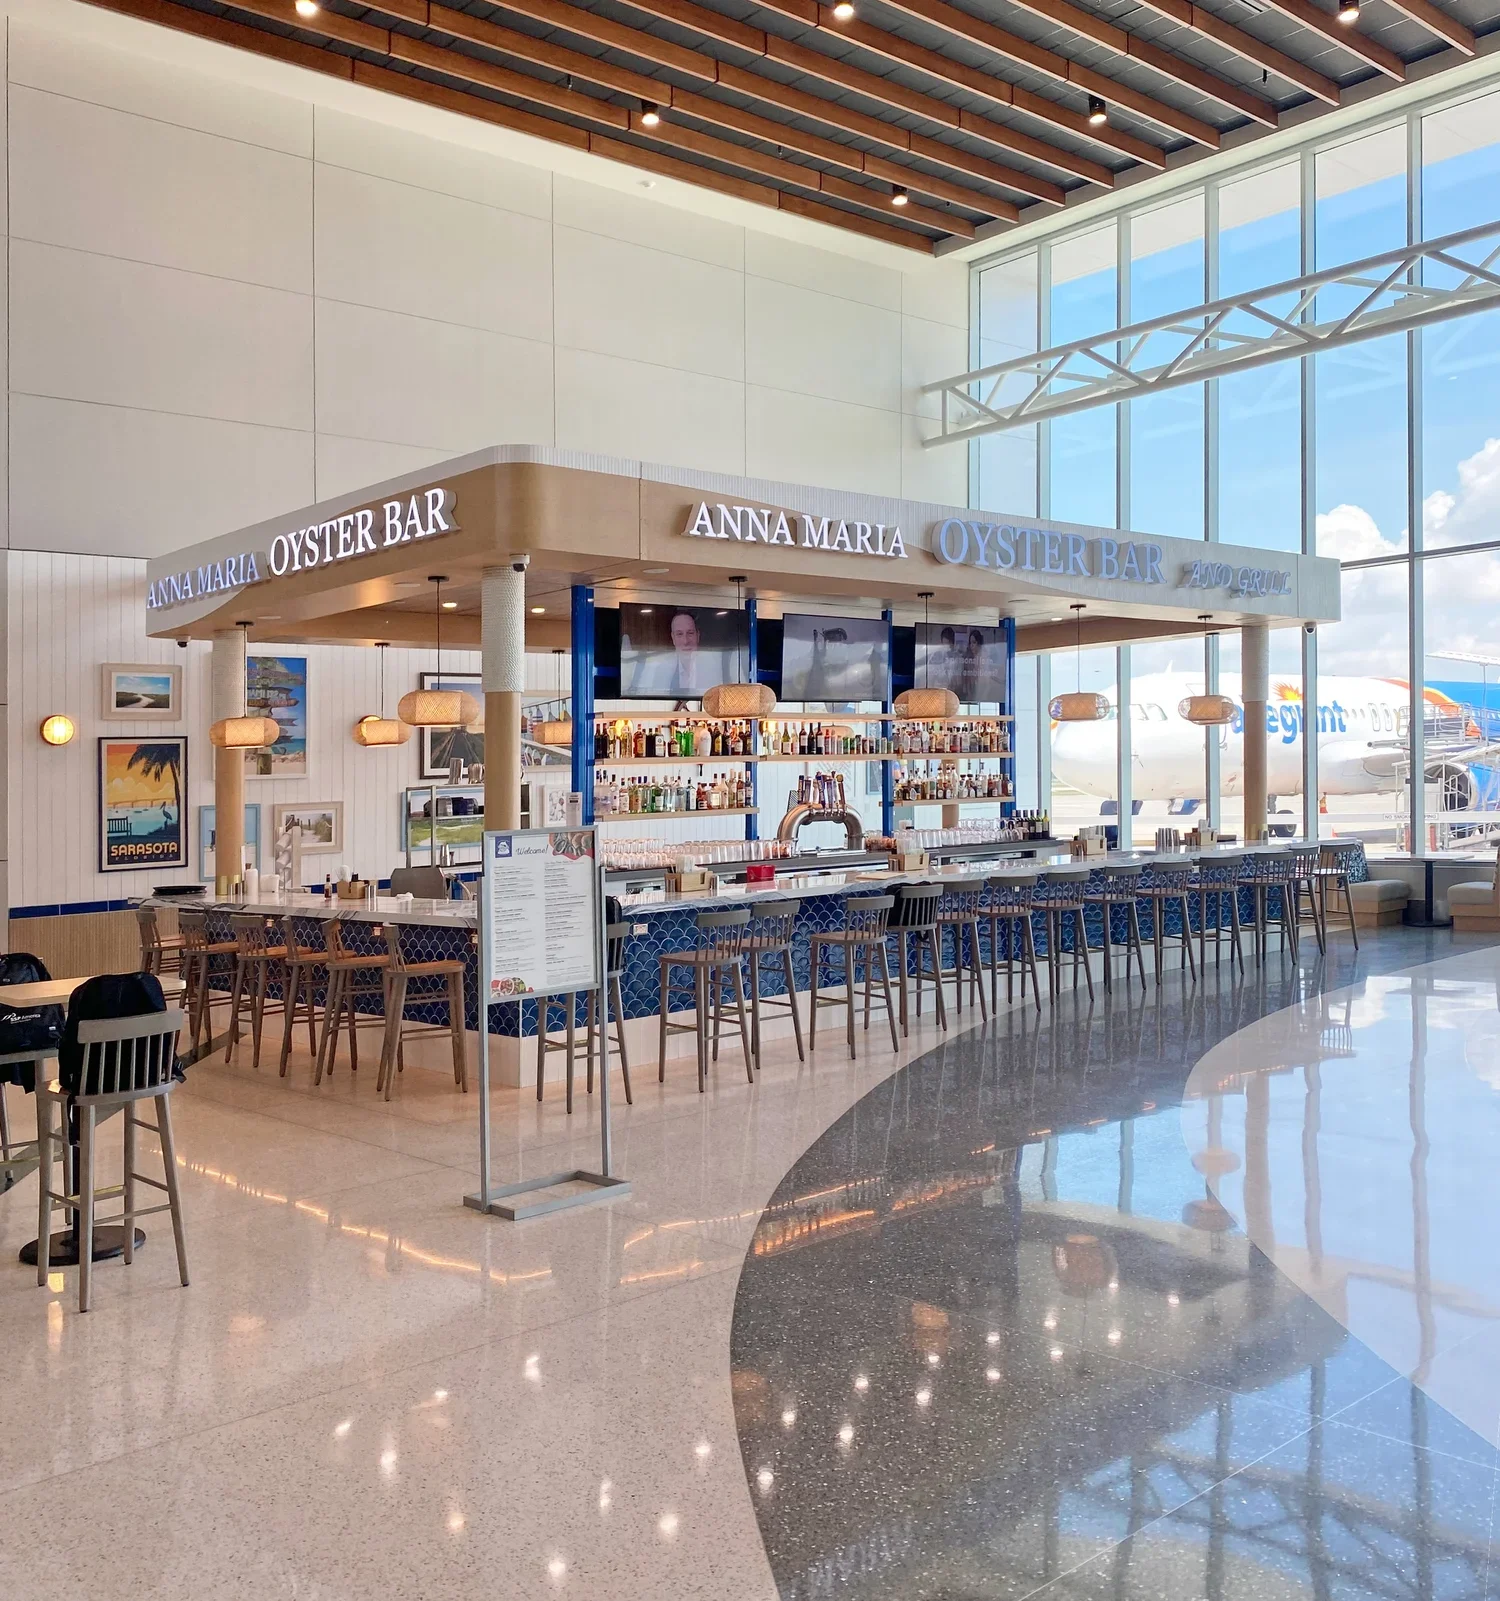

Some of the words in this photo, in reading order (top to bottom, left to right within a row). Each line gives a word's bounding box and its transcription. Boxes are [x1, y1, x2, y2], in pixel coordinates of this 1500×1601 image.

[269, 508, 377, 577] OYSTER
[383, 487, 450, 547] BAR
[688, 501, 795, 547] ANNA
[802, 514, 908, 558] MARIA
[938, 517, 1091, 577] OYSTER
[1099, 537, 1166, 584] BAR
[146, 571, 194, 609] ANNA
[196, 552, 260, 597] MARIA
[1187, 559, 1232, 589] AND
[1238, 567, 1292, 598] GRILL
[110, 841, 178, 857] SARASOTA
[515, 844, 549, 856] Welcome!
